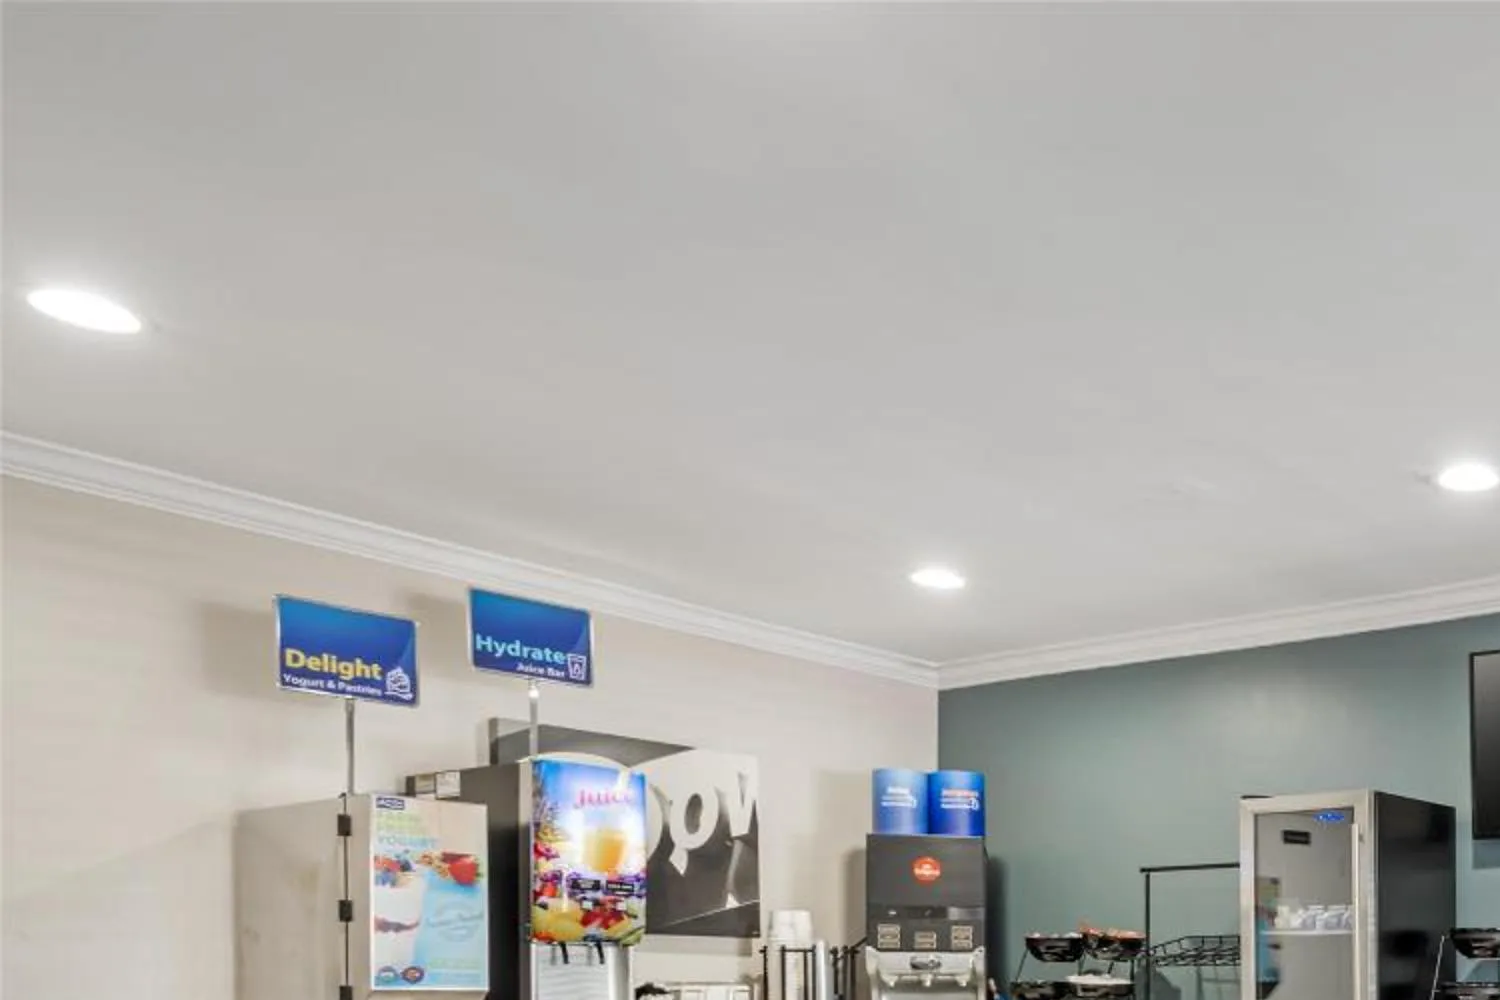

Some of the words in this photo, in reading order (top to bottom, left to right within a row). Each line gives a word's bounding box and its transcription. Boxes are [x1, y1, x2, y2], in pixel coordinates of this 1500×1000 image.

[475, 634, 567, 664] Hydrate
[284, 648, 382, 681] Delight
[516, 662, 546, 675] Juice
[547, 666, 566, 677] Bar
[283, 673, 325, 690] Yogurt
[327, 679, 336, 689] &
[338, 681, 382, 697] Pastries
